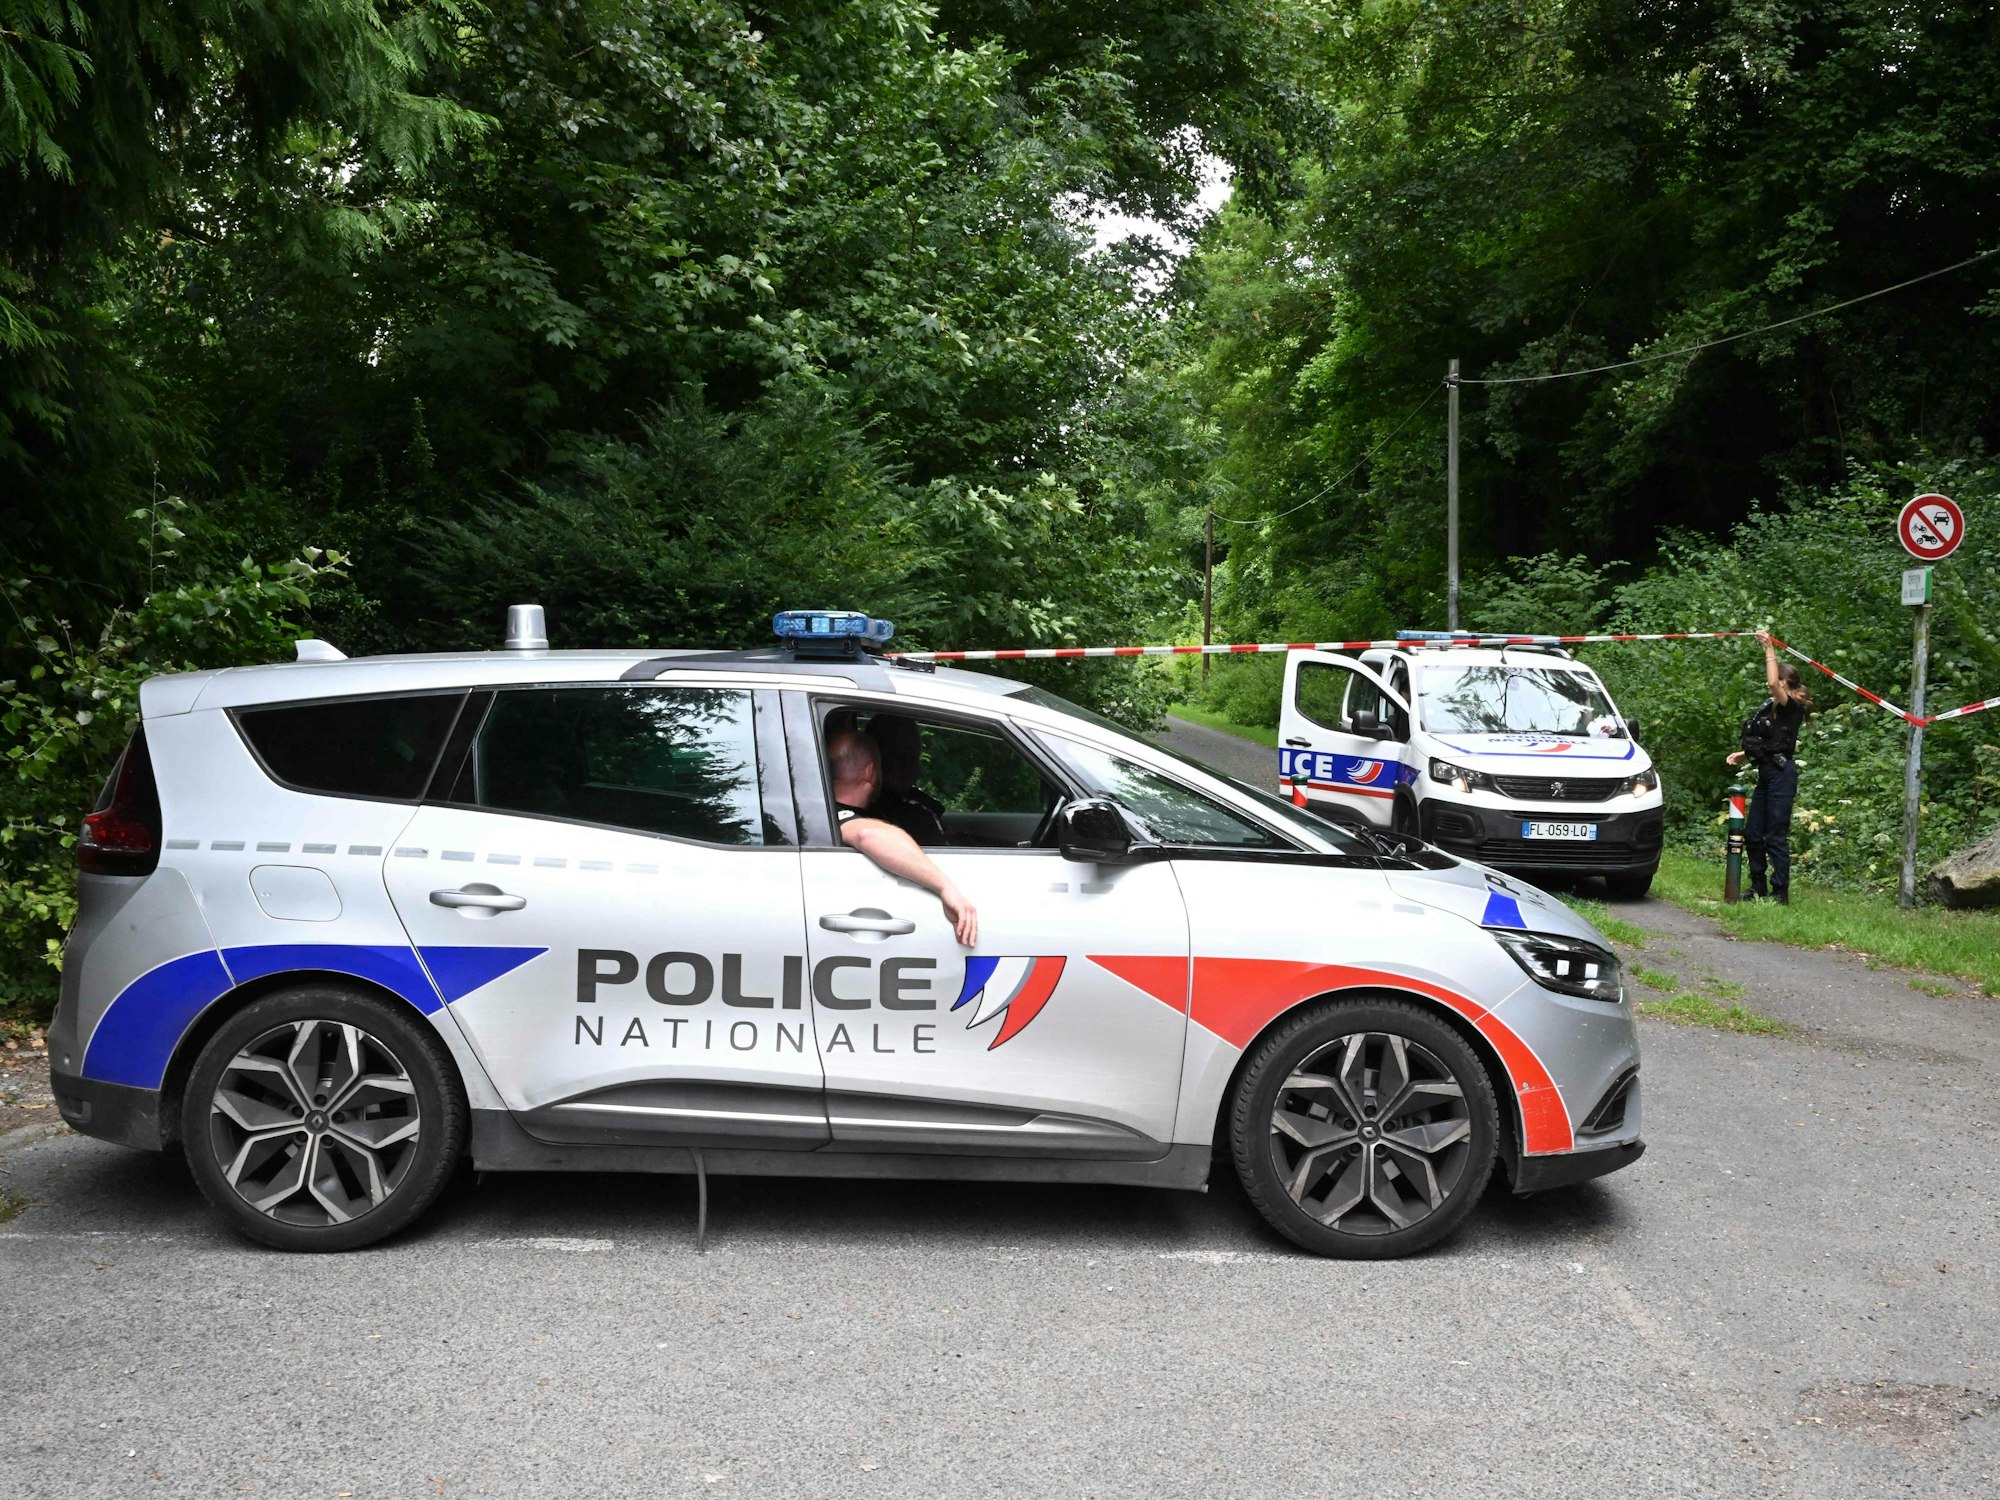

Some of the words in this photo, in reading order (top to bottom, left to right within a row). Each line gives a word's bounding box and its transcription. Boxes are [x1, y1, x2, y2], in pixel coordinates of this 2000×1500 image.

[1281, 751, 1333, 779] ICE
[576, 947, 938, 1011] POLICE
[575, 1015, 937, 1054] NATIONALE
